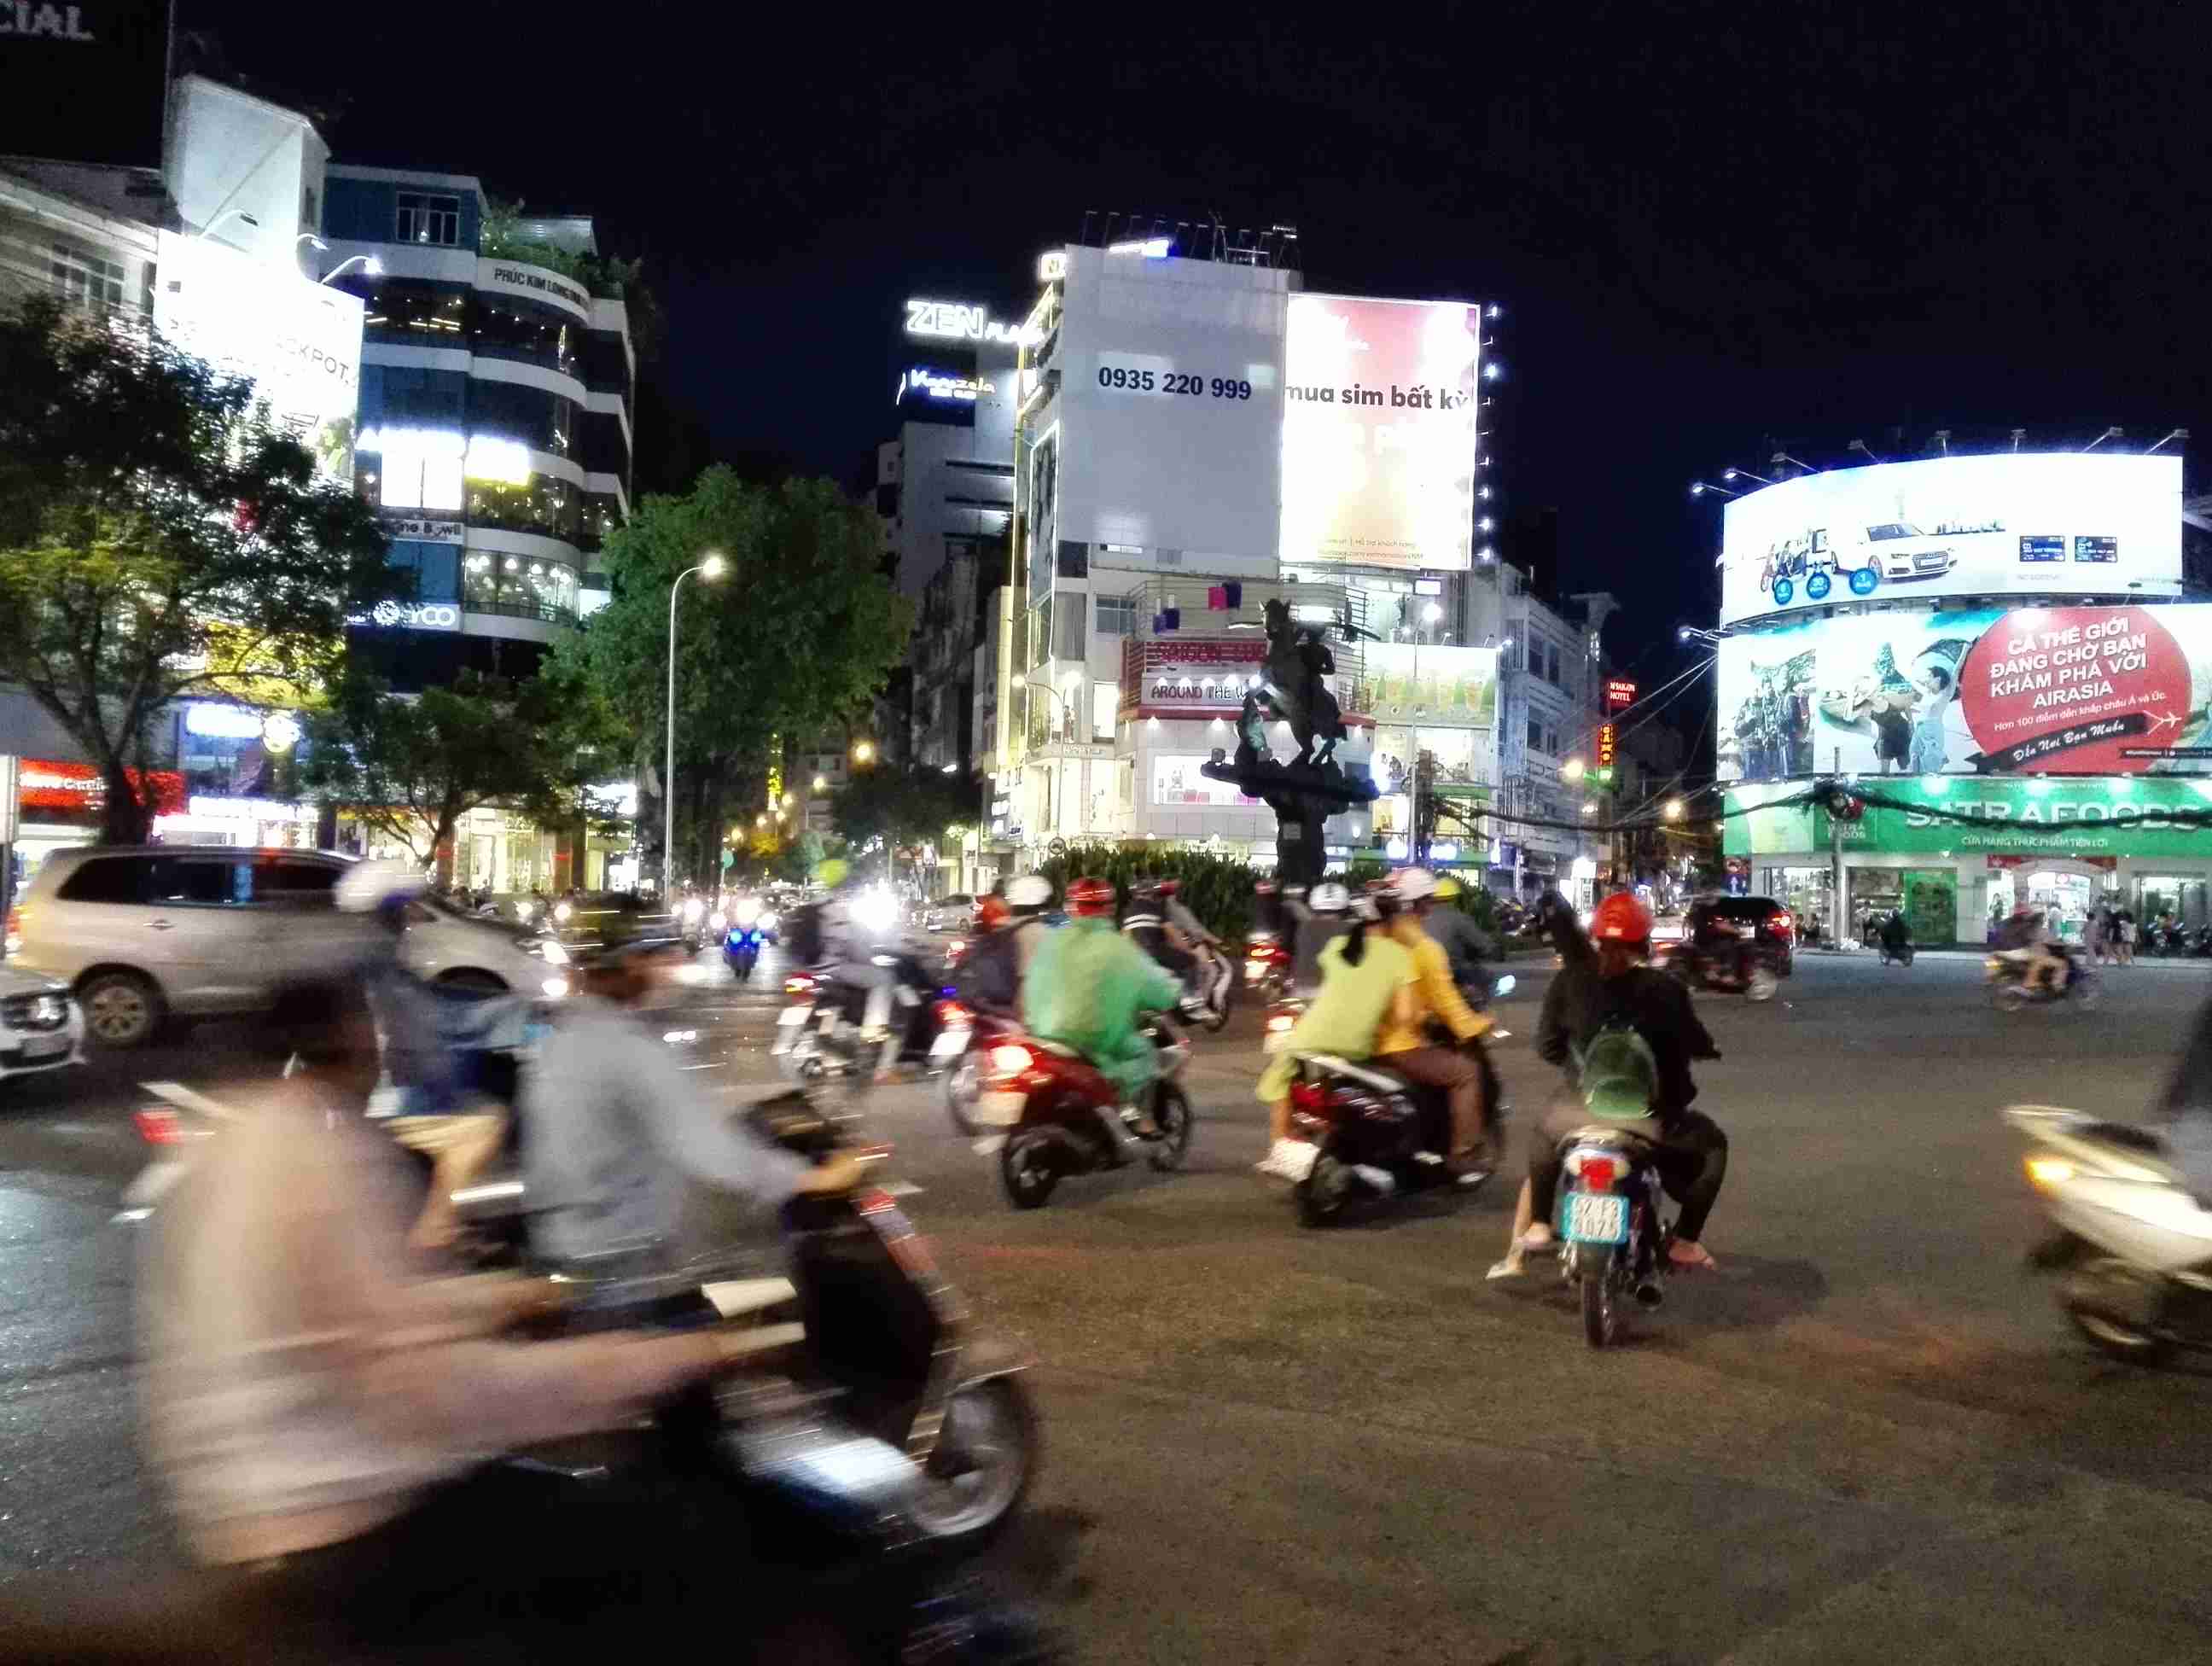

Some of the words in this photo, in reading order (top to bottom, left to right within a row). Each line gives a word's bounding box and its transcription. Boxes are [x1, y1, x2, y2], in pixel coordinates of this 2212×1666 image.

[906, 300, 983, 339] ZEN
[1098, 366, 1154, 391] 0935
[1162, 373, 1203, 396] 220
[1211, 378, 1252, 400] 999
[1284, 385, 1335, 403] mua
[1342, 383, 1383, 406] sim
[1391, 384, 1433, 409] bất
[2085, 615, 2129, 640] GIỚI
[1990, 655, 2048, 679] ĐANG
[2052, 642, 2099, 666] CHỜ
[2103, 632, 2146, 657] BẠN
[1990, 669, 2052, 697] KHÁM
[2058, 661, 2102, 686] PHÁ
[2107, 652, 2148, 674] VỚI
[1150, 684, 1202, 699] AROUND
[1206, 684, 1231, 700] THE
[2033, 680, 2114, 709] AIRASIA
[2017, 715, 2034, 726] 100
